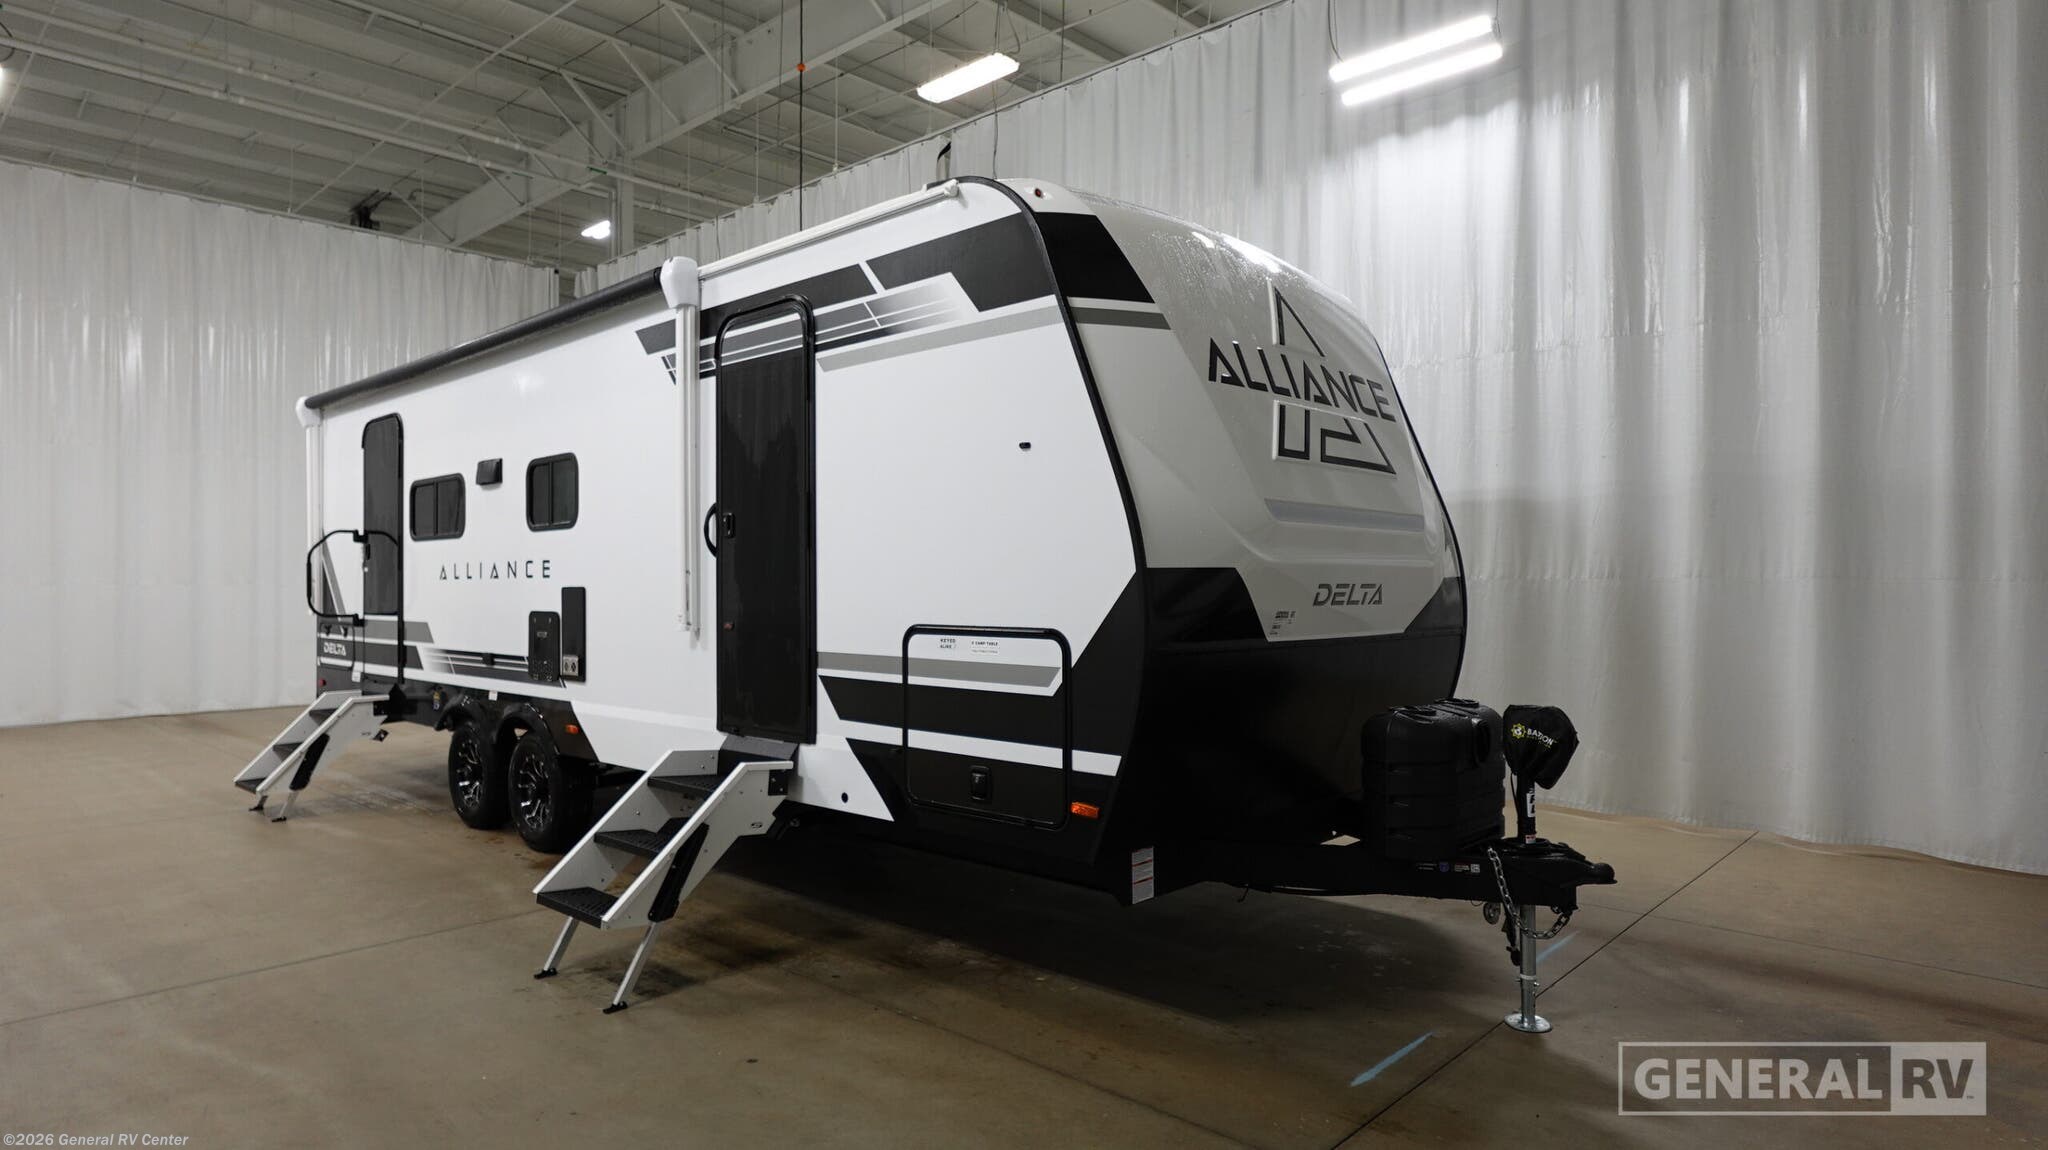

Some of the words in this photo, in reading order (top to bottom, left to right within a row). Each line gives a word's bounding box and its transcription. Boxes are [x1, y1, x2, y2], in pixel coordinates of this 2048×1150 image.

[1208, 336, 1397, 422] ALLIANCE
[439, 559, 551, 580] ALLIANCE
[1312, 583, 1384, 607] DELTA
[323, 641, 347, 656] DELTA
